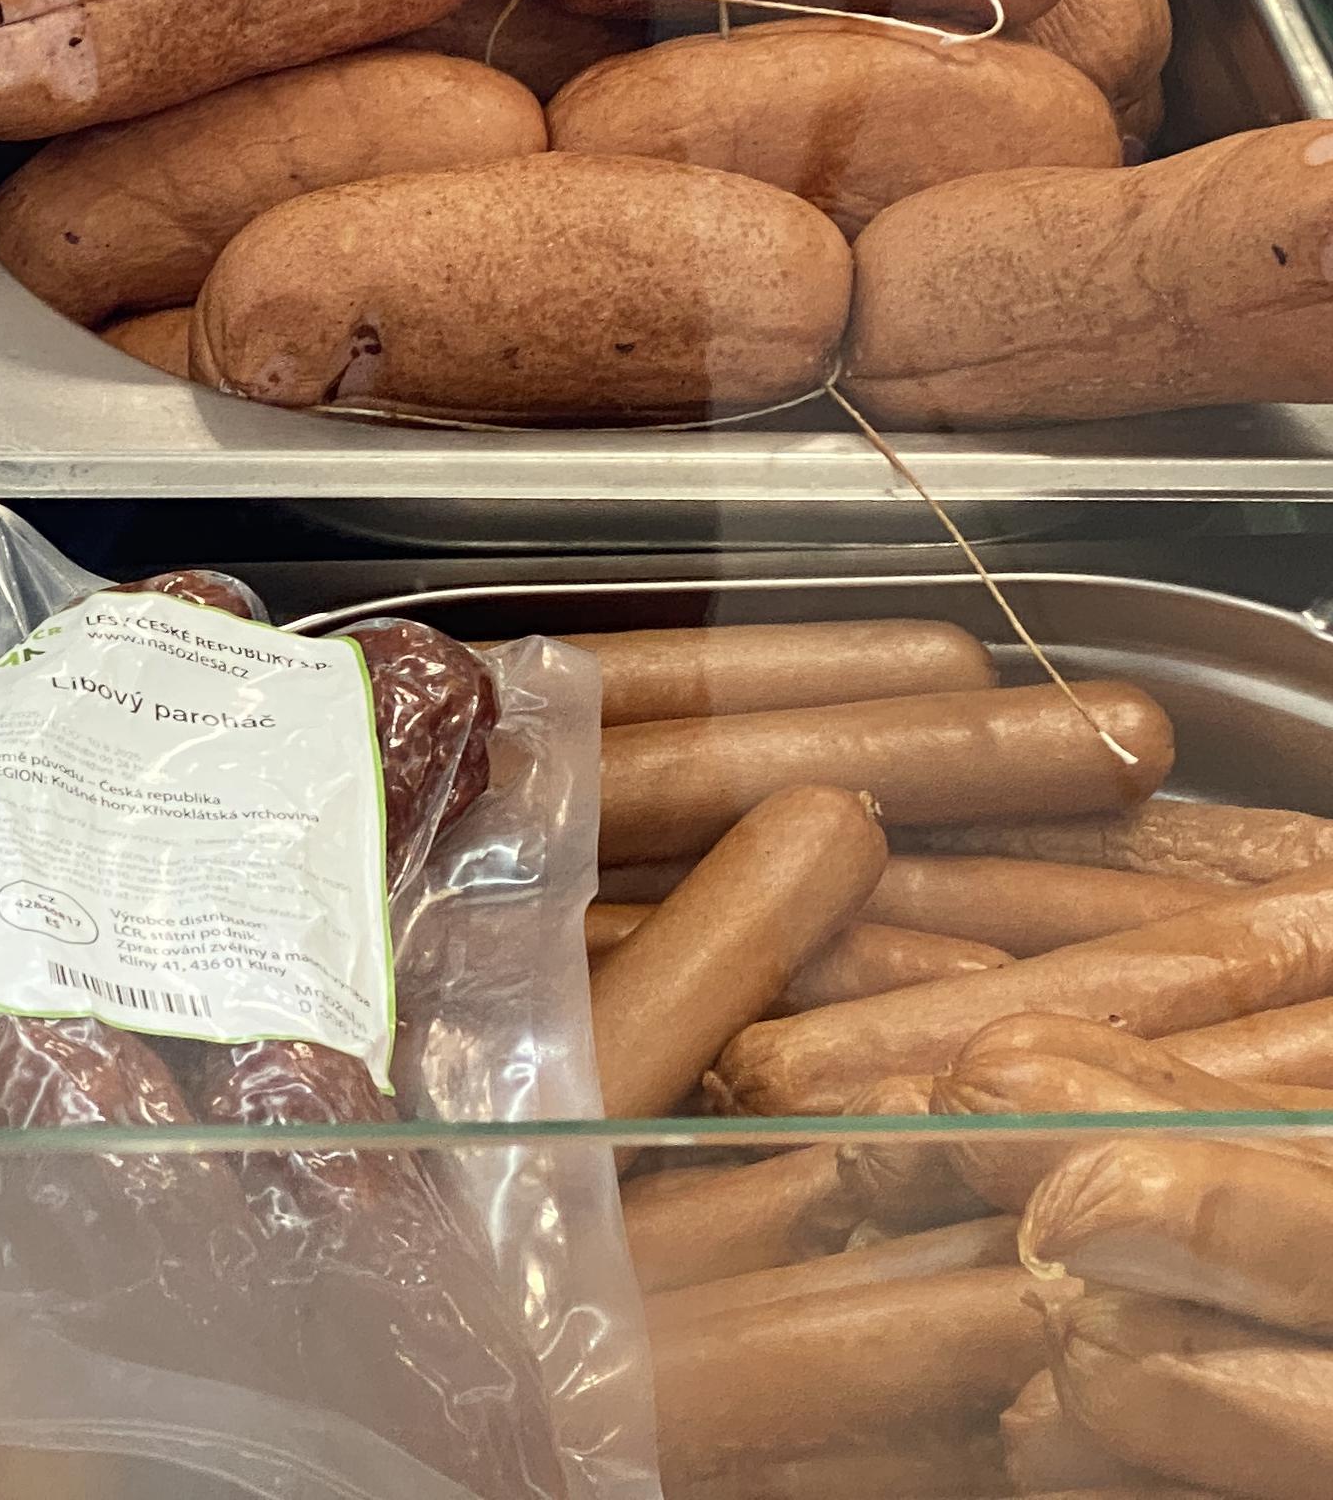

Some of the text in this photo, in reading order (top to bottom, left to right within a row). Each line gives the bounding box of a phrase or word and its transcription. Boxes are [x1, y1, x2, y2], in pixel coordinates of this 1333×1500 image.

[195, 635, 294, 669] REPUBLIKY
[51, 675, 277, 730] Libový paroháč
[31, 755, 84, 785] původu
[99, 780, 143, 800] Česká
[146, 790, 221, 807] republika
[51, 775, 98, 803] Krušné
[100, 796, 140, 815] hory,
[142, 803, 238, 822] Křivoklátská
[241, 808, 320, 824] vrchovina
[109, 908, 175, 922] Výrobce
[162, 960, 187, 972] 41,
[190, 958, 221, 971] 436
[223, 957, 243, 969] 01
[271, 951, 281, 961] a
